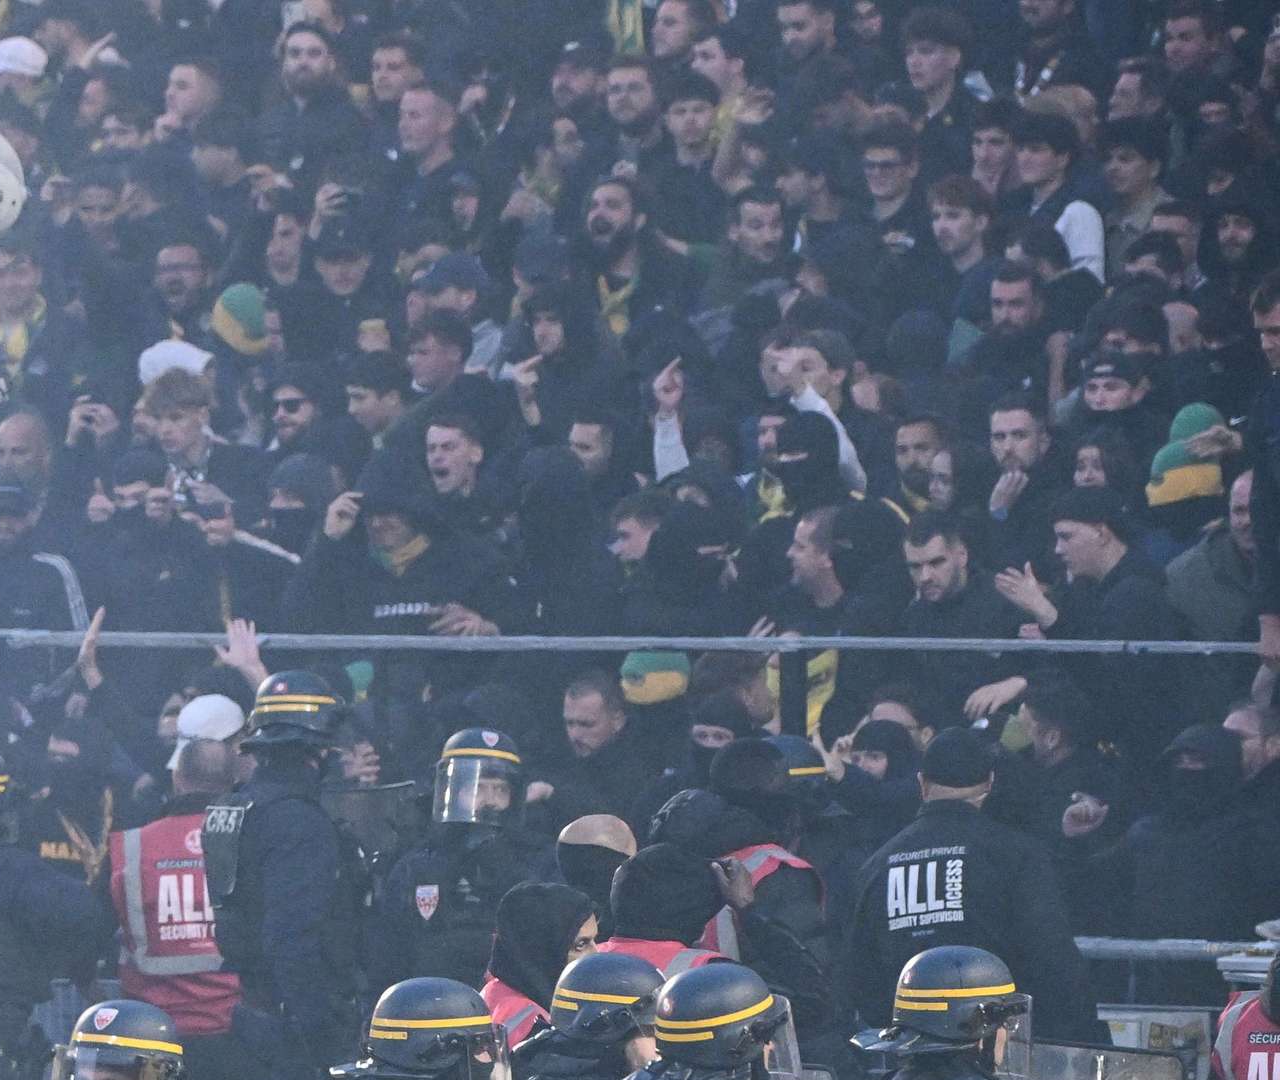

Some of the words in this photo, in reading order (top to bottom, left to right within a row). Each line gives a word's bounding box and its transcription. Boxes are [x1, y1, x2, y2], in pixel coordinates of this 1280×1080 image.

[206, 809, 236, 833] CRS
[887, 861, 945, 918] ALL
[945, 859, 963, 908] ACCESS
[888, 914, 918, 931] SECURITY
